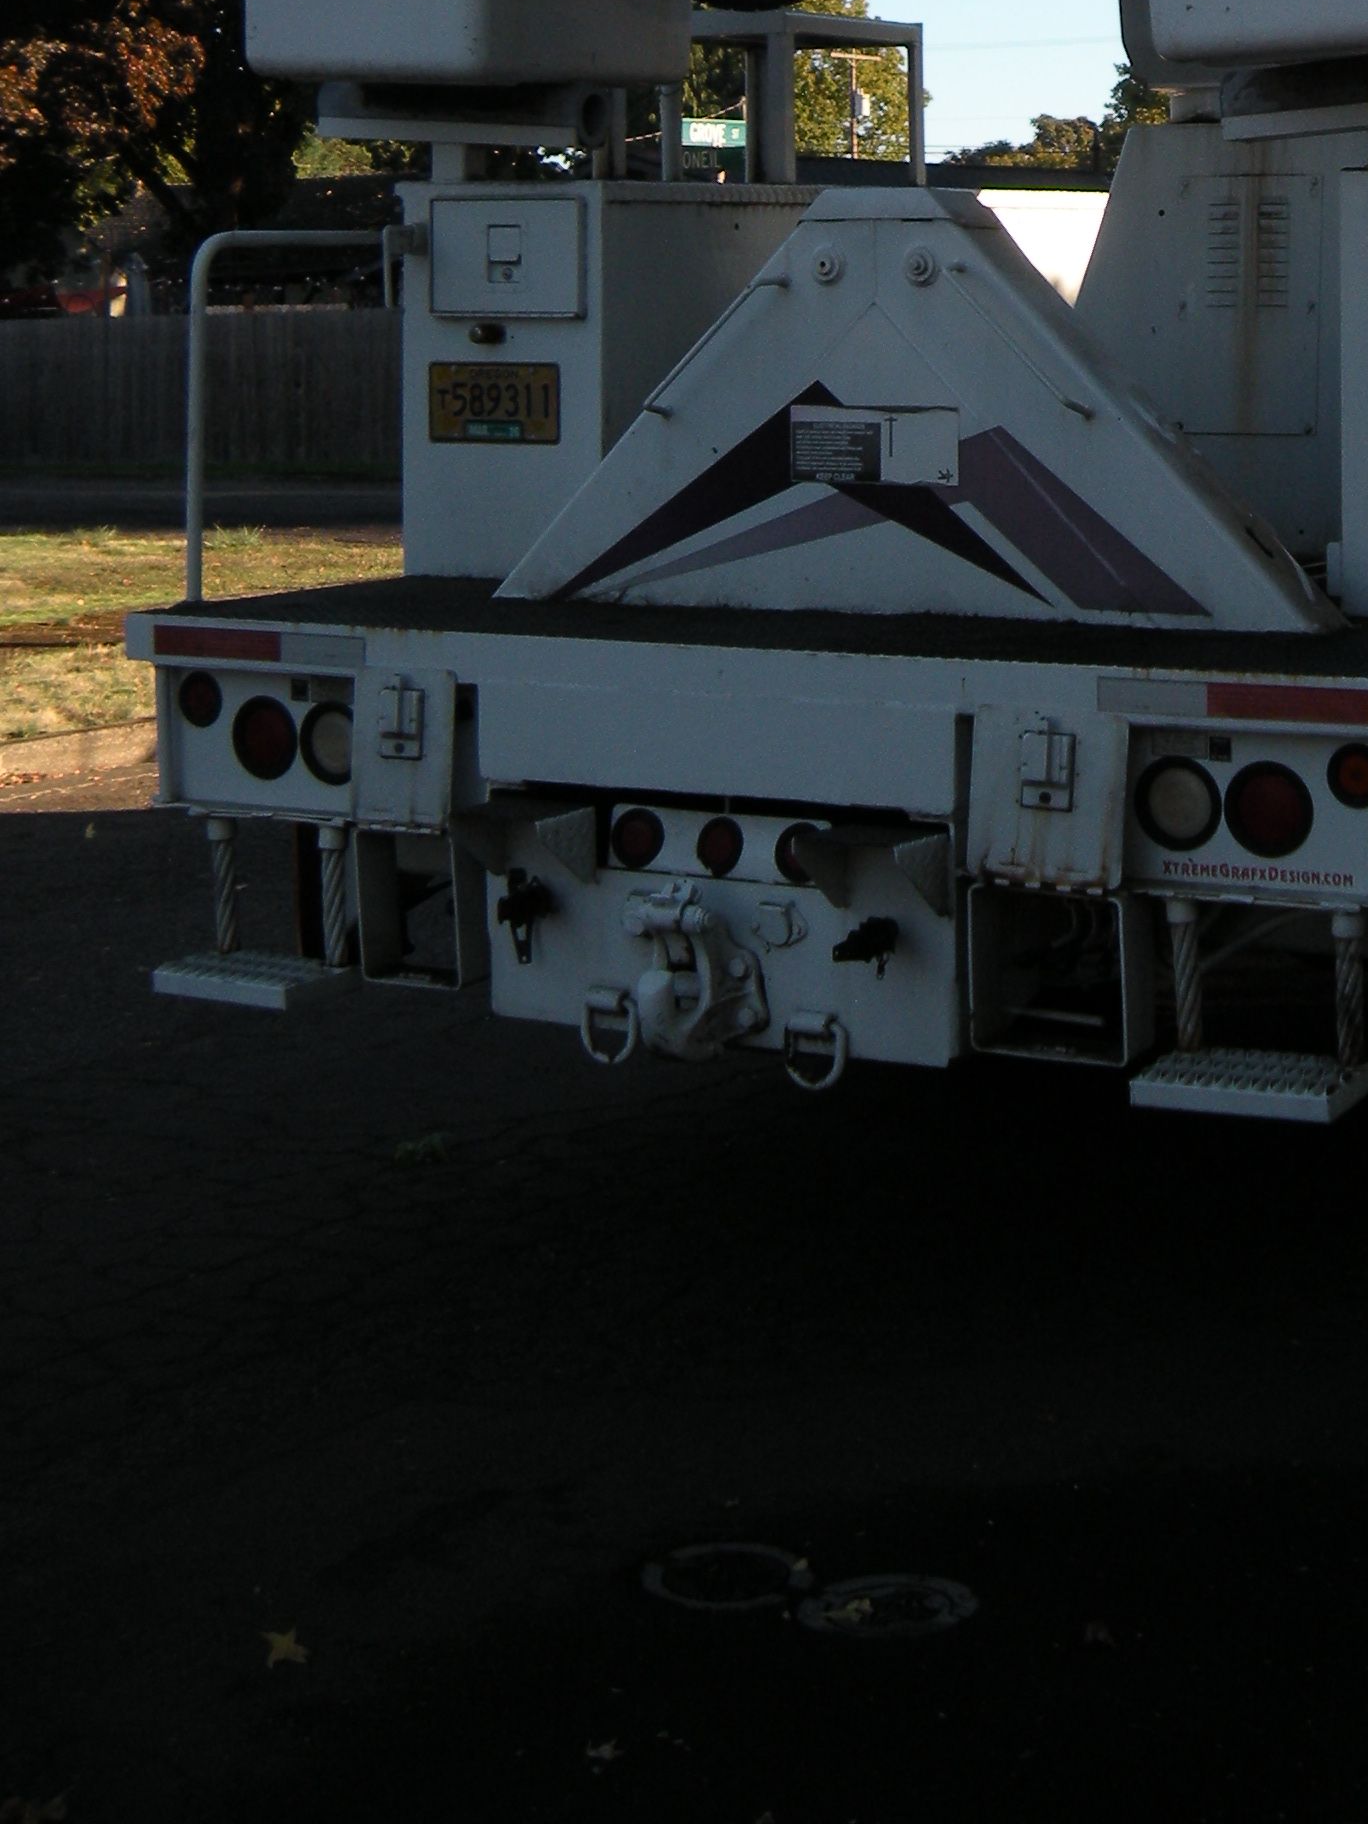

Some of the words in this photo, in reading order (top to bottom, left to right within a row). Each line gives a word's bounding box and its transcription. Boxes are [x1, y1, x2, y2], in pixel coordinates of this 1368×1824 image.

[689, 122, 727, 144] GROVE
[469, 367, 519, 379] OREGON
[436, 382, 550, 419] T589311
[816, 472, 832, 481] KEEP
[833, 472, 856, 481] CLEAR
